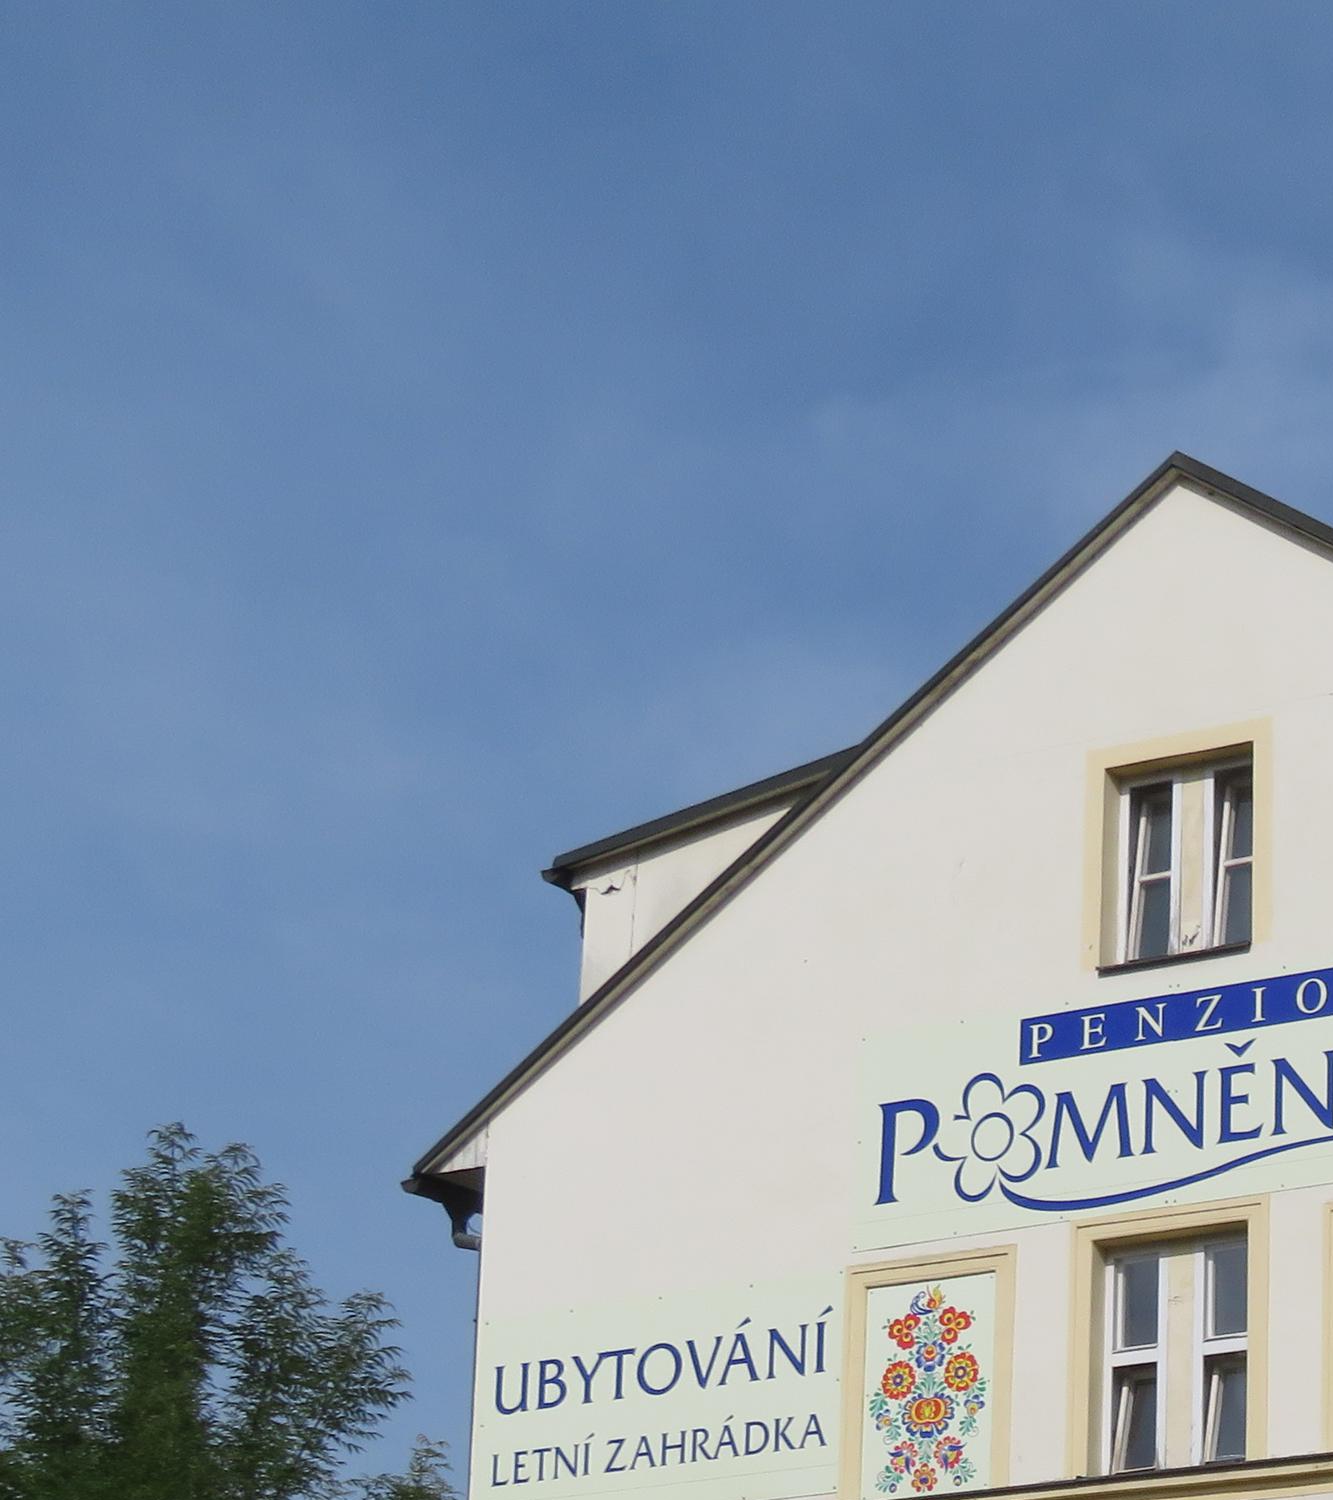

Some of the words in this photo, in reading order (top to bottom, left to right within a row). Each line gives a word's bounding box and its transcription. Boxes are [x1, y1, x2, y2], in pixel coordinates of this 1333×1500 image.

[493, 1305, 834, 1416] UBYTOVÁNÍ
[490, 1433, 595, 1488] LETNÍ
[603, 1412, 828, 1474] ZAHRÁDKA
